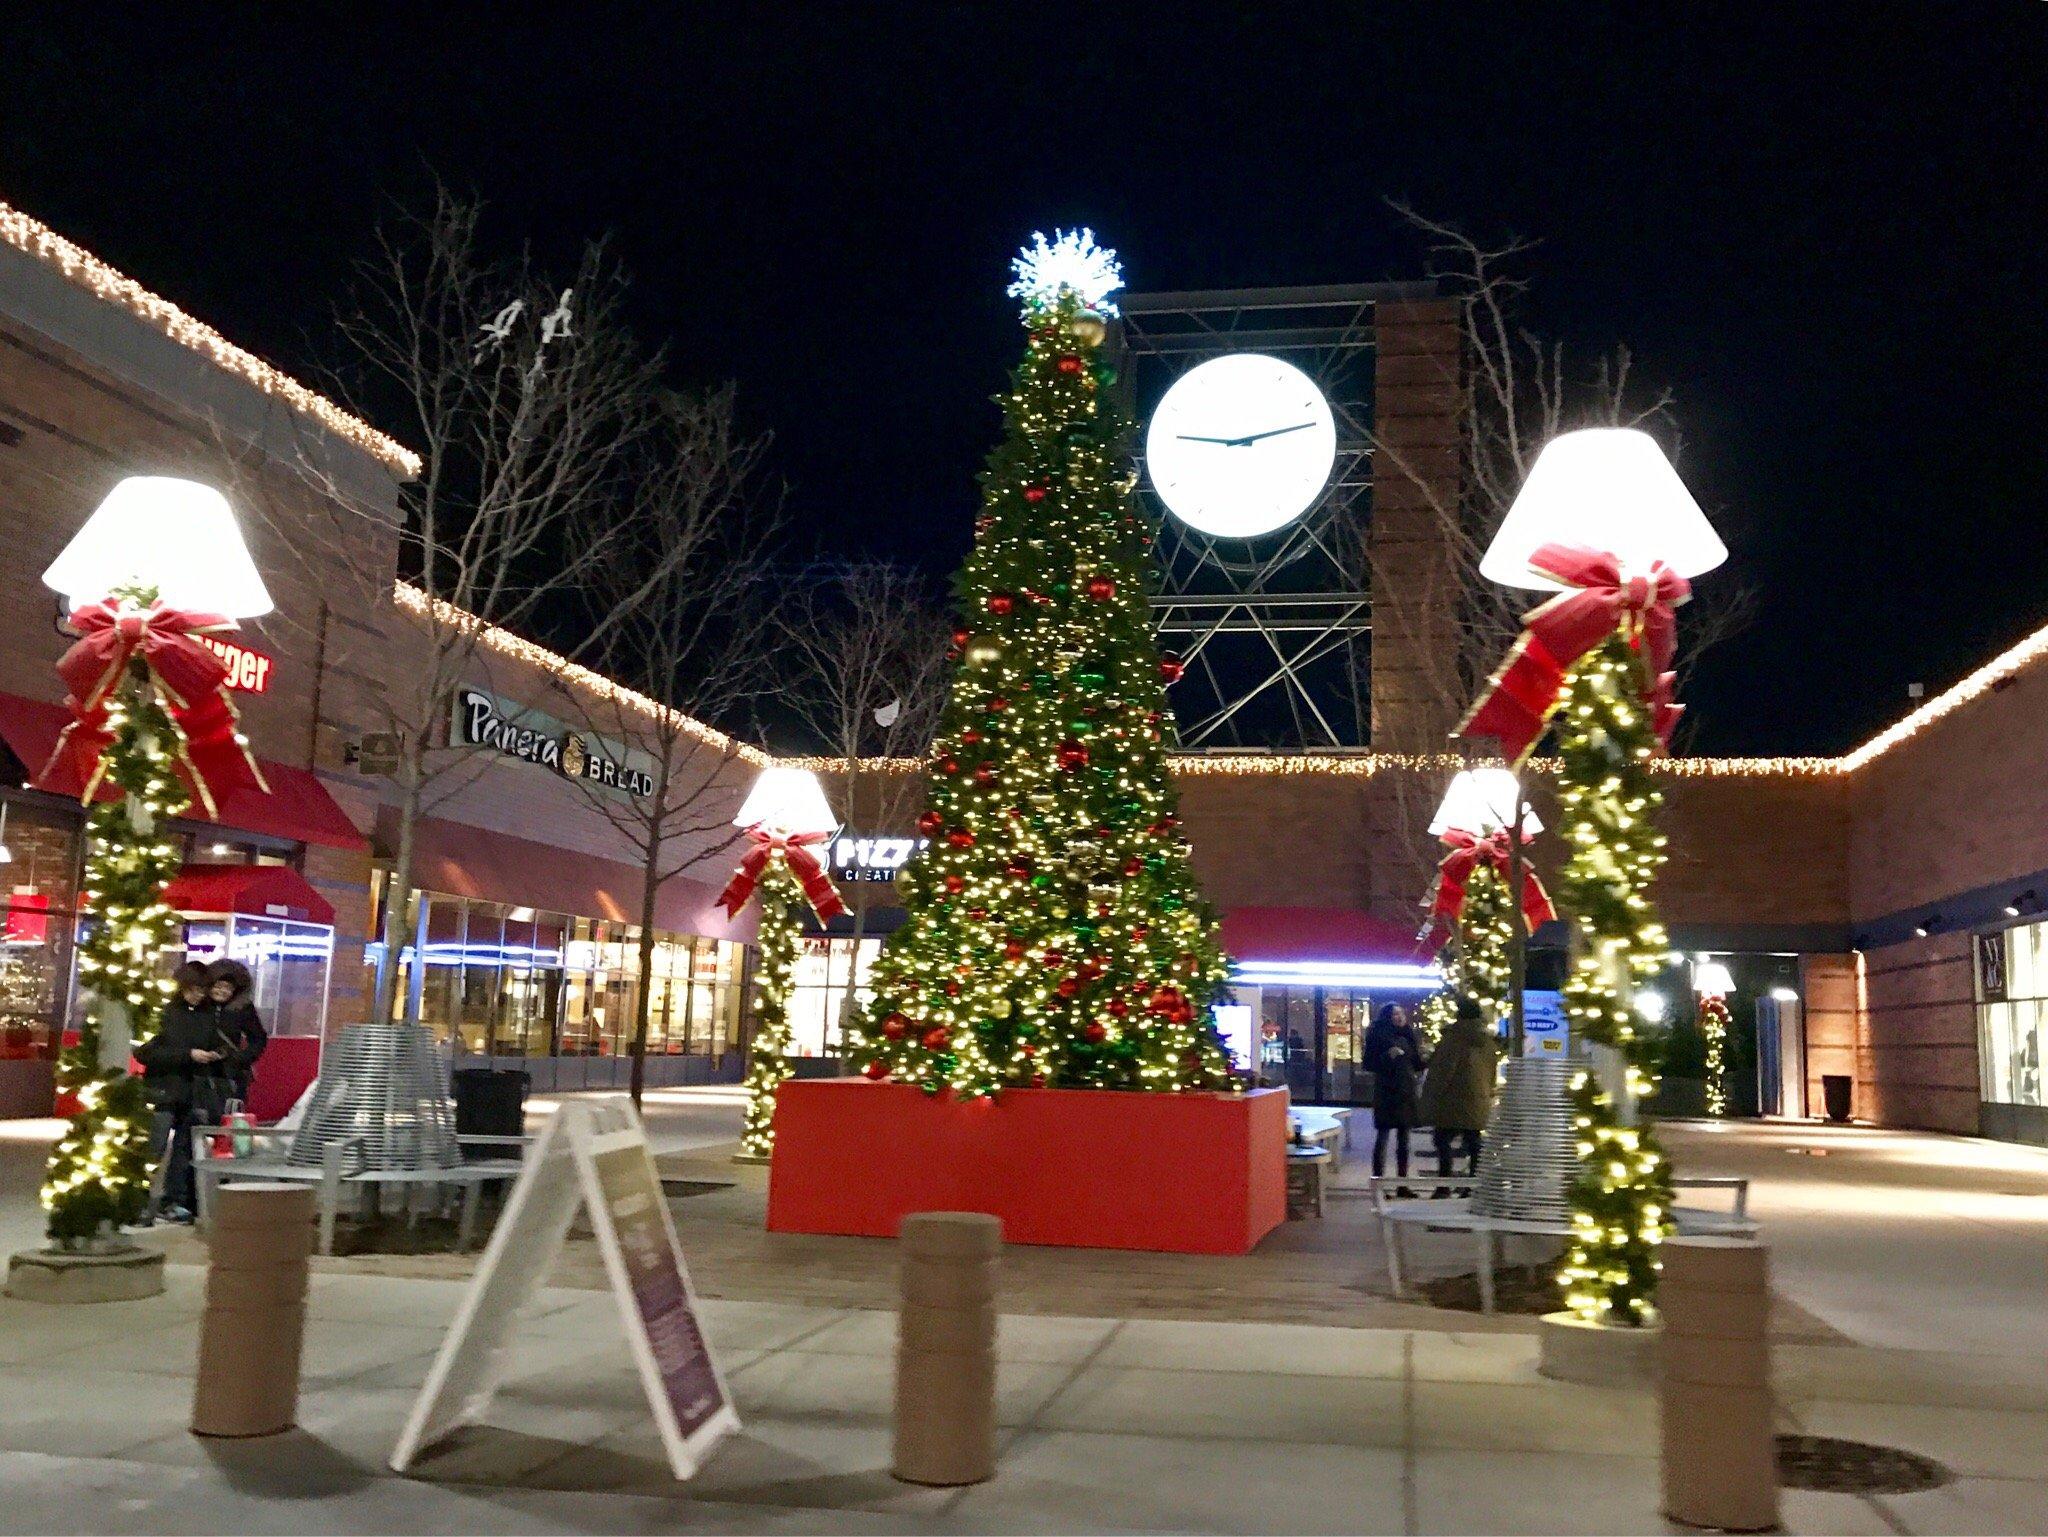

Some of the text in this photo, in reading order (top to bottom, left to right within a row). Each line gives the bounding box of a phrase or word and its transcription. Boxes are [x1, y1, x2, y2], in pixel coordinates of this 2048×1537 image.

[467, 692, 653, 797] Panera BREAD
[836, 838, 930, 868] PIZZ
